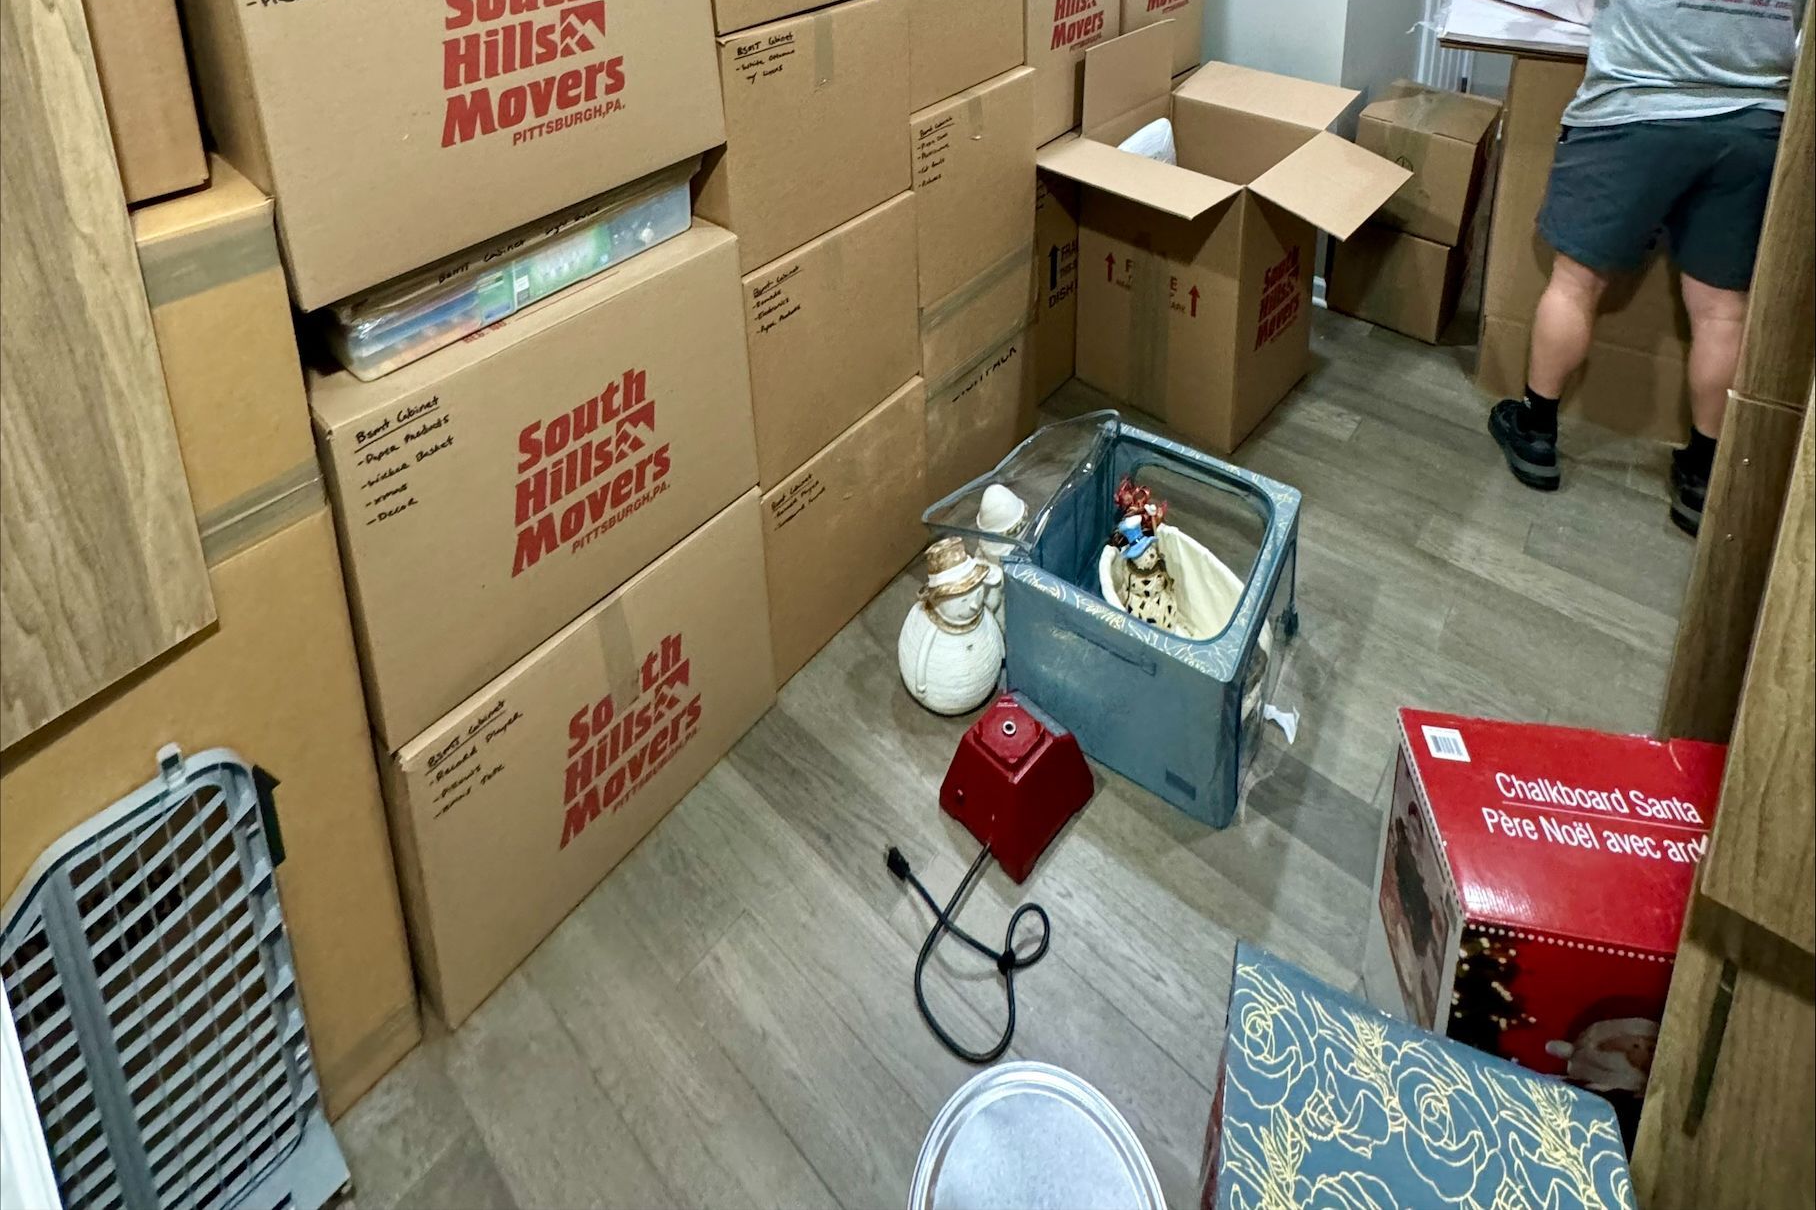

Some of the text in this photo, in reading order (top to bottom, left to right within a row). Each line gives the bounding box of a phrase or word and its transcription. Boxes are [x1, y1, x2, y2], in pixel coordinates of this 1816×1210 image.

[442, 20, 558, 90] Hills
[1050, 10, 1104, 50] Movers
[441, 56, 626, 148] Movers
[355, 395, 439, 444] Bsmt Cabinet
[517, 367, 646, 474] South
[511, 442, 671, 578] Movers
[515, 436, 614, 528] Hills
[568, 632, 682, 759] Soth
[559, 692, 702, 852] Movers
[563, 701, 651, 806] Hills
[1494, 772, 1704, 824] Chalkboard Santa
[1481, 807, 1539, 840] Père
[1539, 815, 1600, 850] Noël
[1602, 828, 1661, 859] avec
